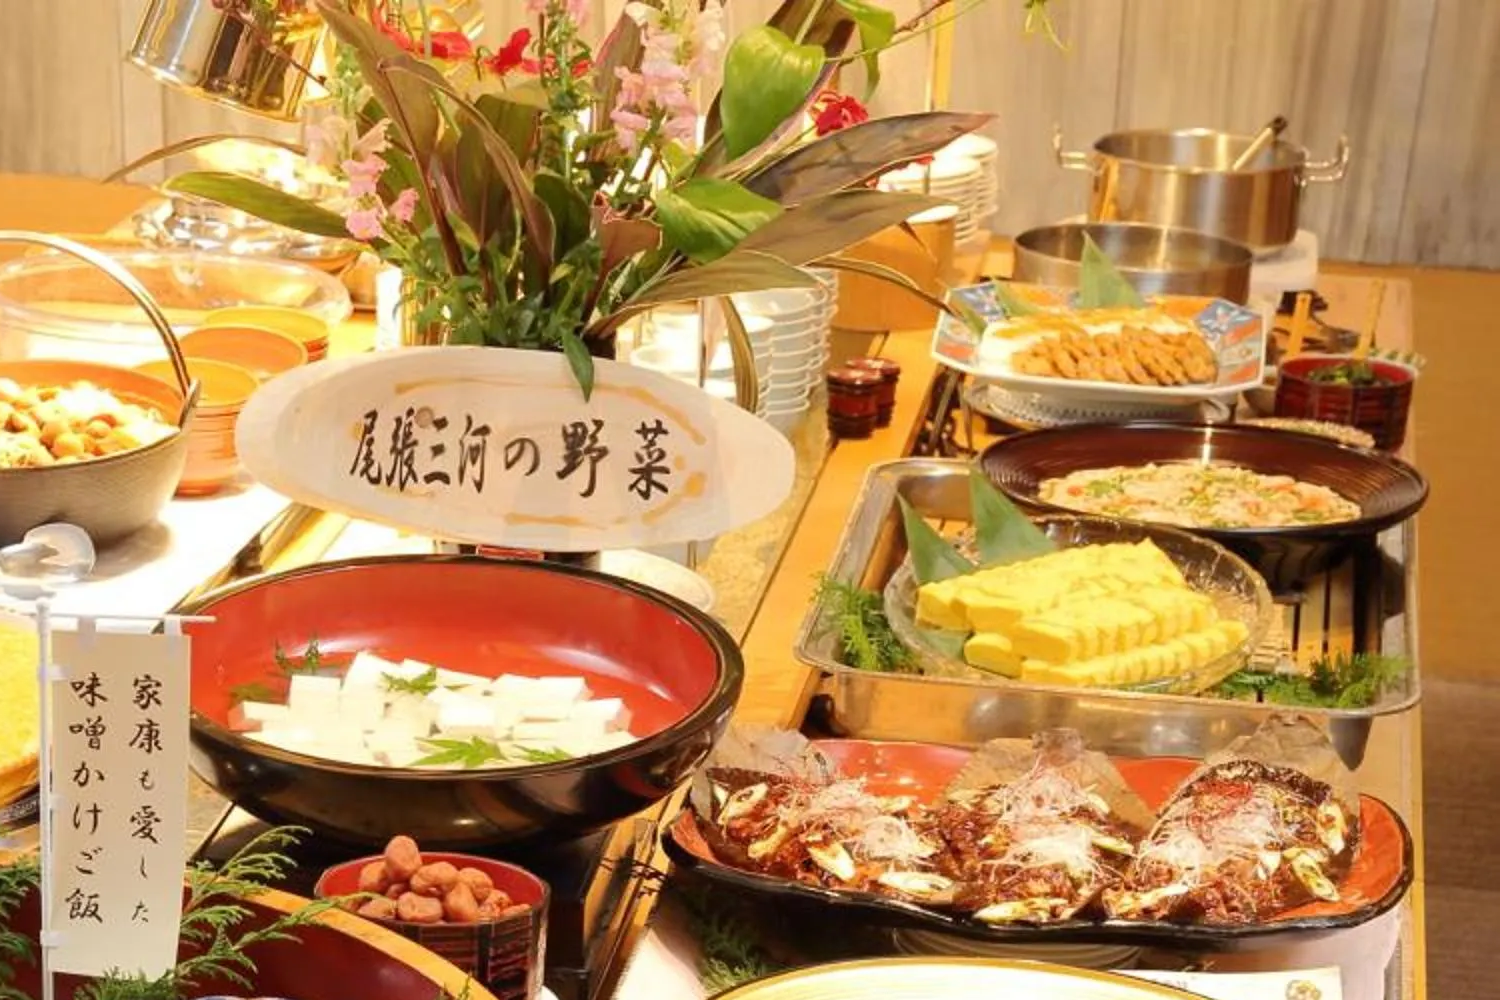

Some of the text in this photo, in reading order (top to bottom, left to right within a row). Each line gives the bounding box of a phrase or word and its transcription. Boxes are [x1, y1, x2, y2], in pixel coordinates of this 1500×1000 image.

[349, 406, 671, 500] 尾張三河の野菜
[65, 672, 109, 923] 味噌かけご飯
[129, 674, 163, 923] 家康も愛した
